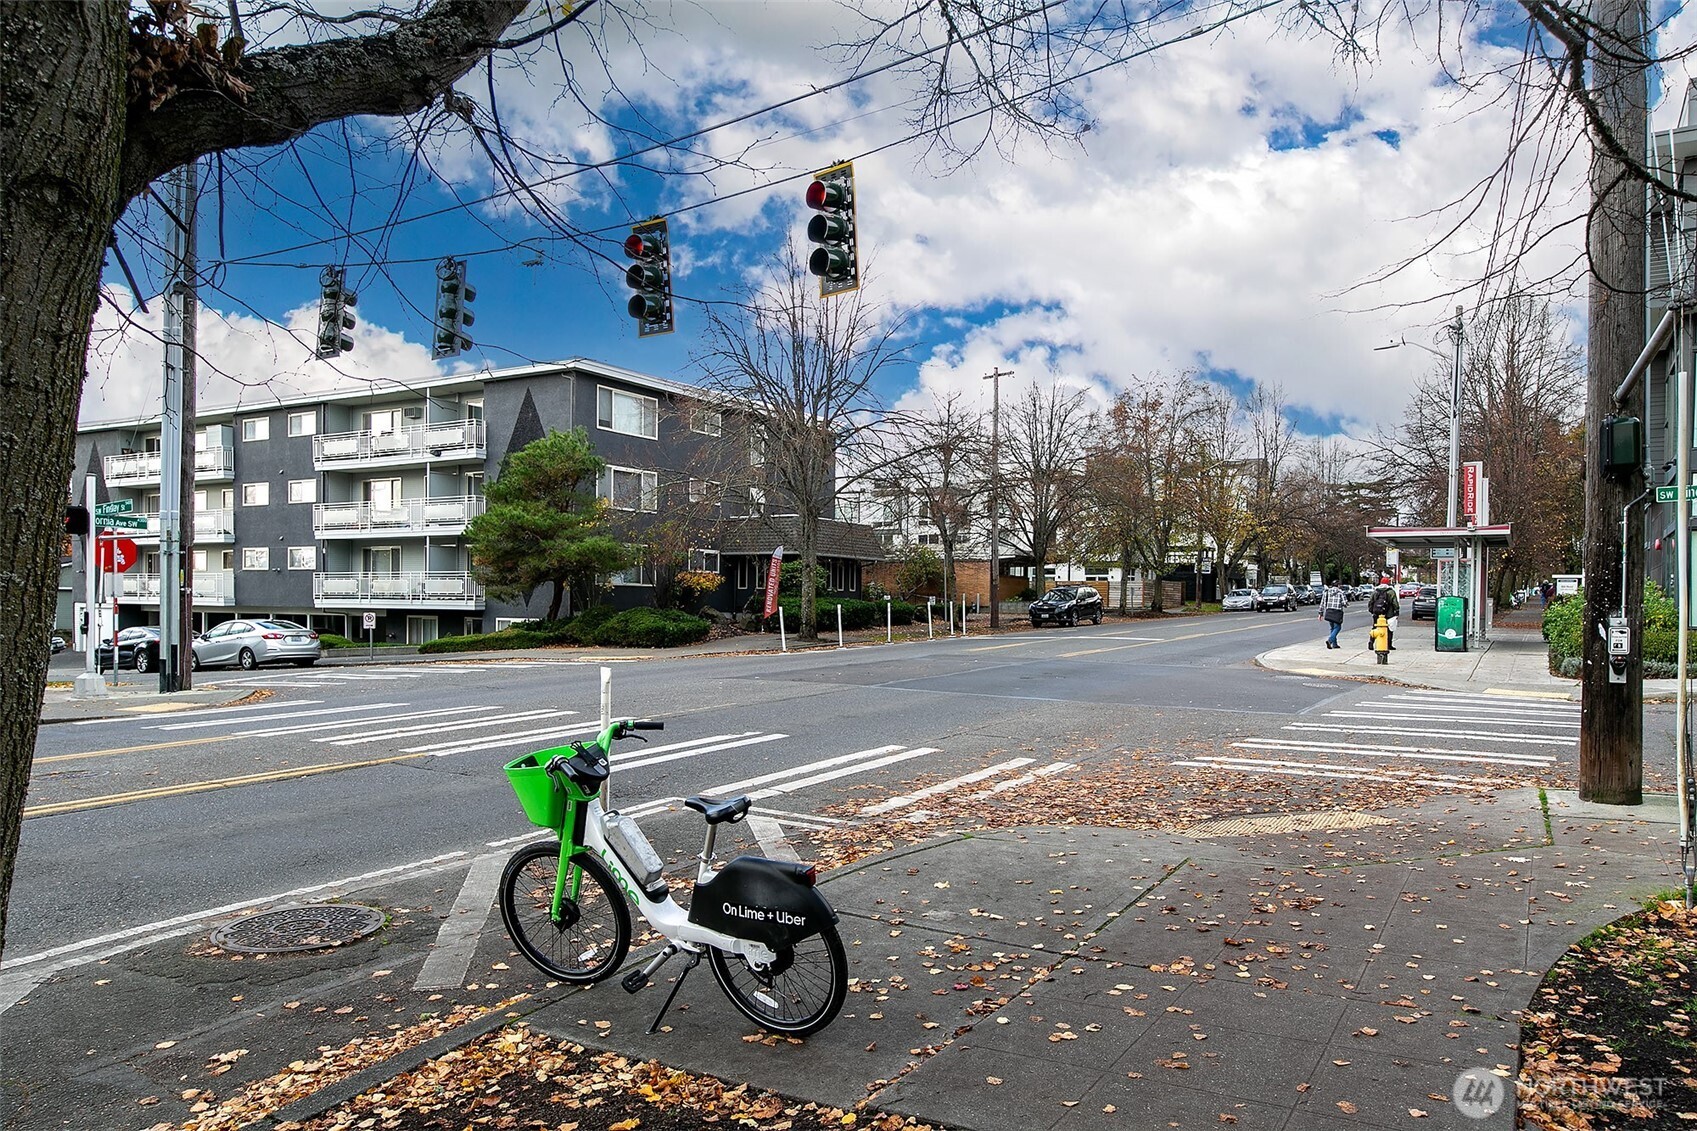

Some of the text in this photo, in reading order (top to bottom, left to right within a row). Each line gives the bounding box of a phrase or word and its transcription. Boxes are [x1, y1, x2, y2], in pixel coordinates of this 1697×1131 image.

[1659, 491, 1674, 500] SW
[102, 503, 119, 514] Findlay
[95, 517, 115, 526] ornia
[115, 519, 127, 527] Ave
[127, 520, 138, 528] SW
[770, 559, 778, 577] UNITS
[722, 902, 738, 916] On
[738, 905, 766, 921] Lime
[776, 910, 806, 926] Uber
